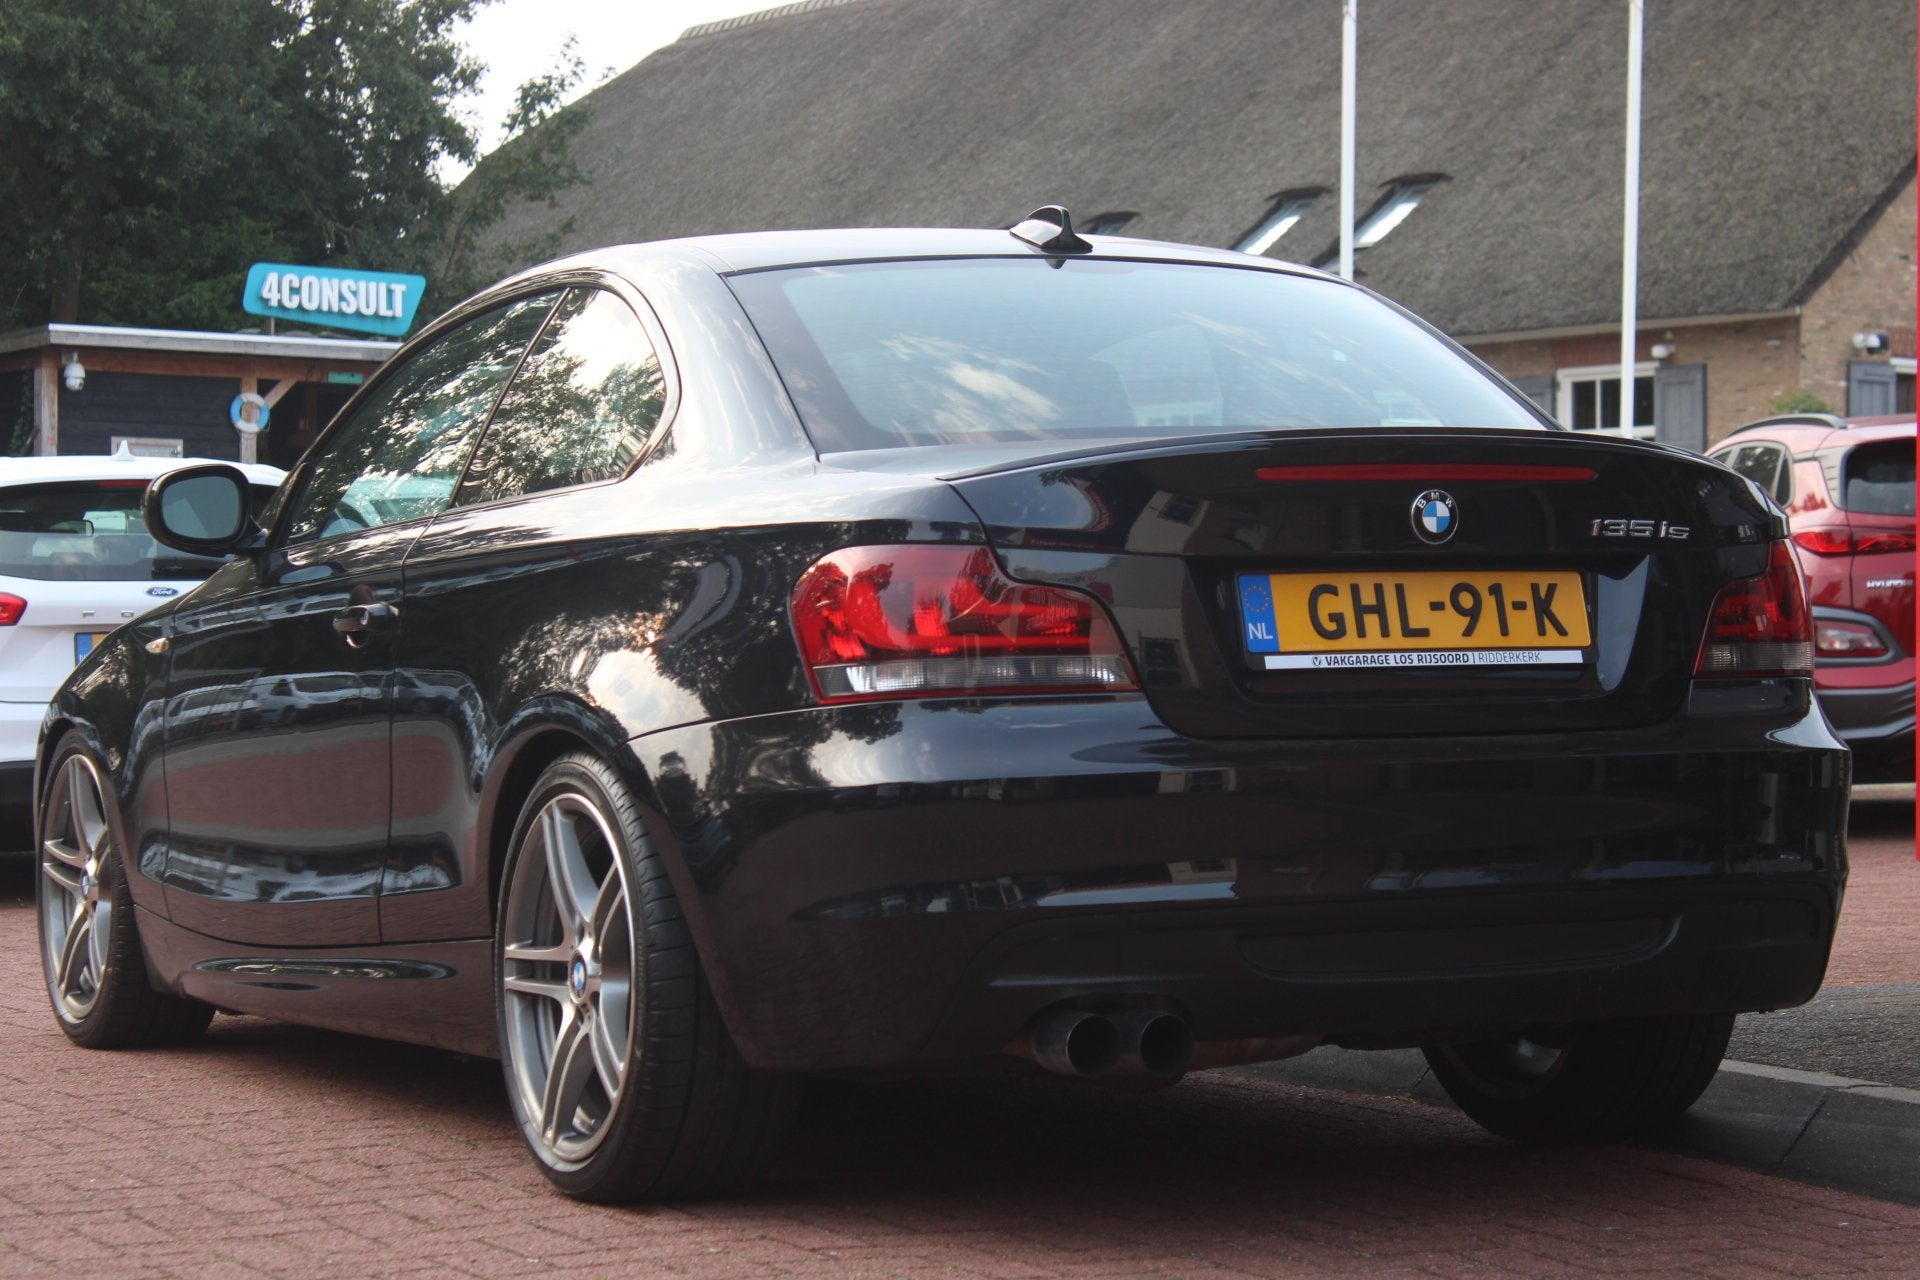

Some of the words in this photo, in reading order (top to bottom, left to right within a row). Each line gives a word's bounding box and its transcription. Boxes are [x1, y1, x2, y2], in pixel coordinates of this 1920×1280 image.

[261, 271, 407, 318] 4CONSULT
[1416, 491, 1454, 509] BMW
[1308, 582, 1568, 641] GHL-91-K
[1248, 622, 1273, 640] NL
[1325, 655, 1391, 666] VAKGARAGE
[1393, 653, 1414, 665] LOS
[1417, 652, 1470, 665] RIJSOORD
[1478, 651, 1542, 663] RIDDERKERK
